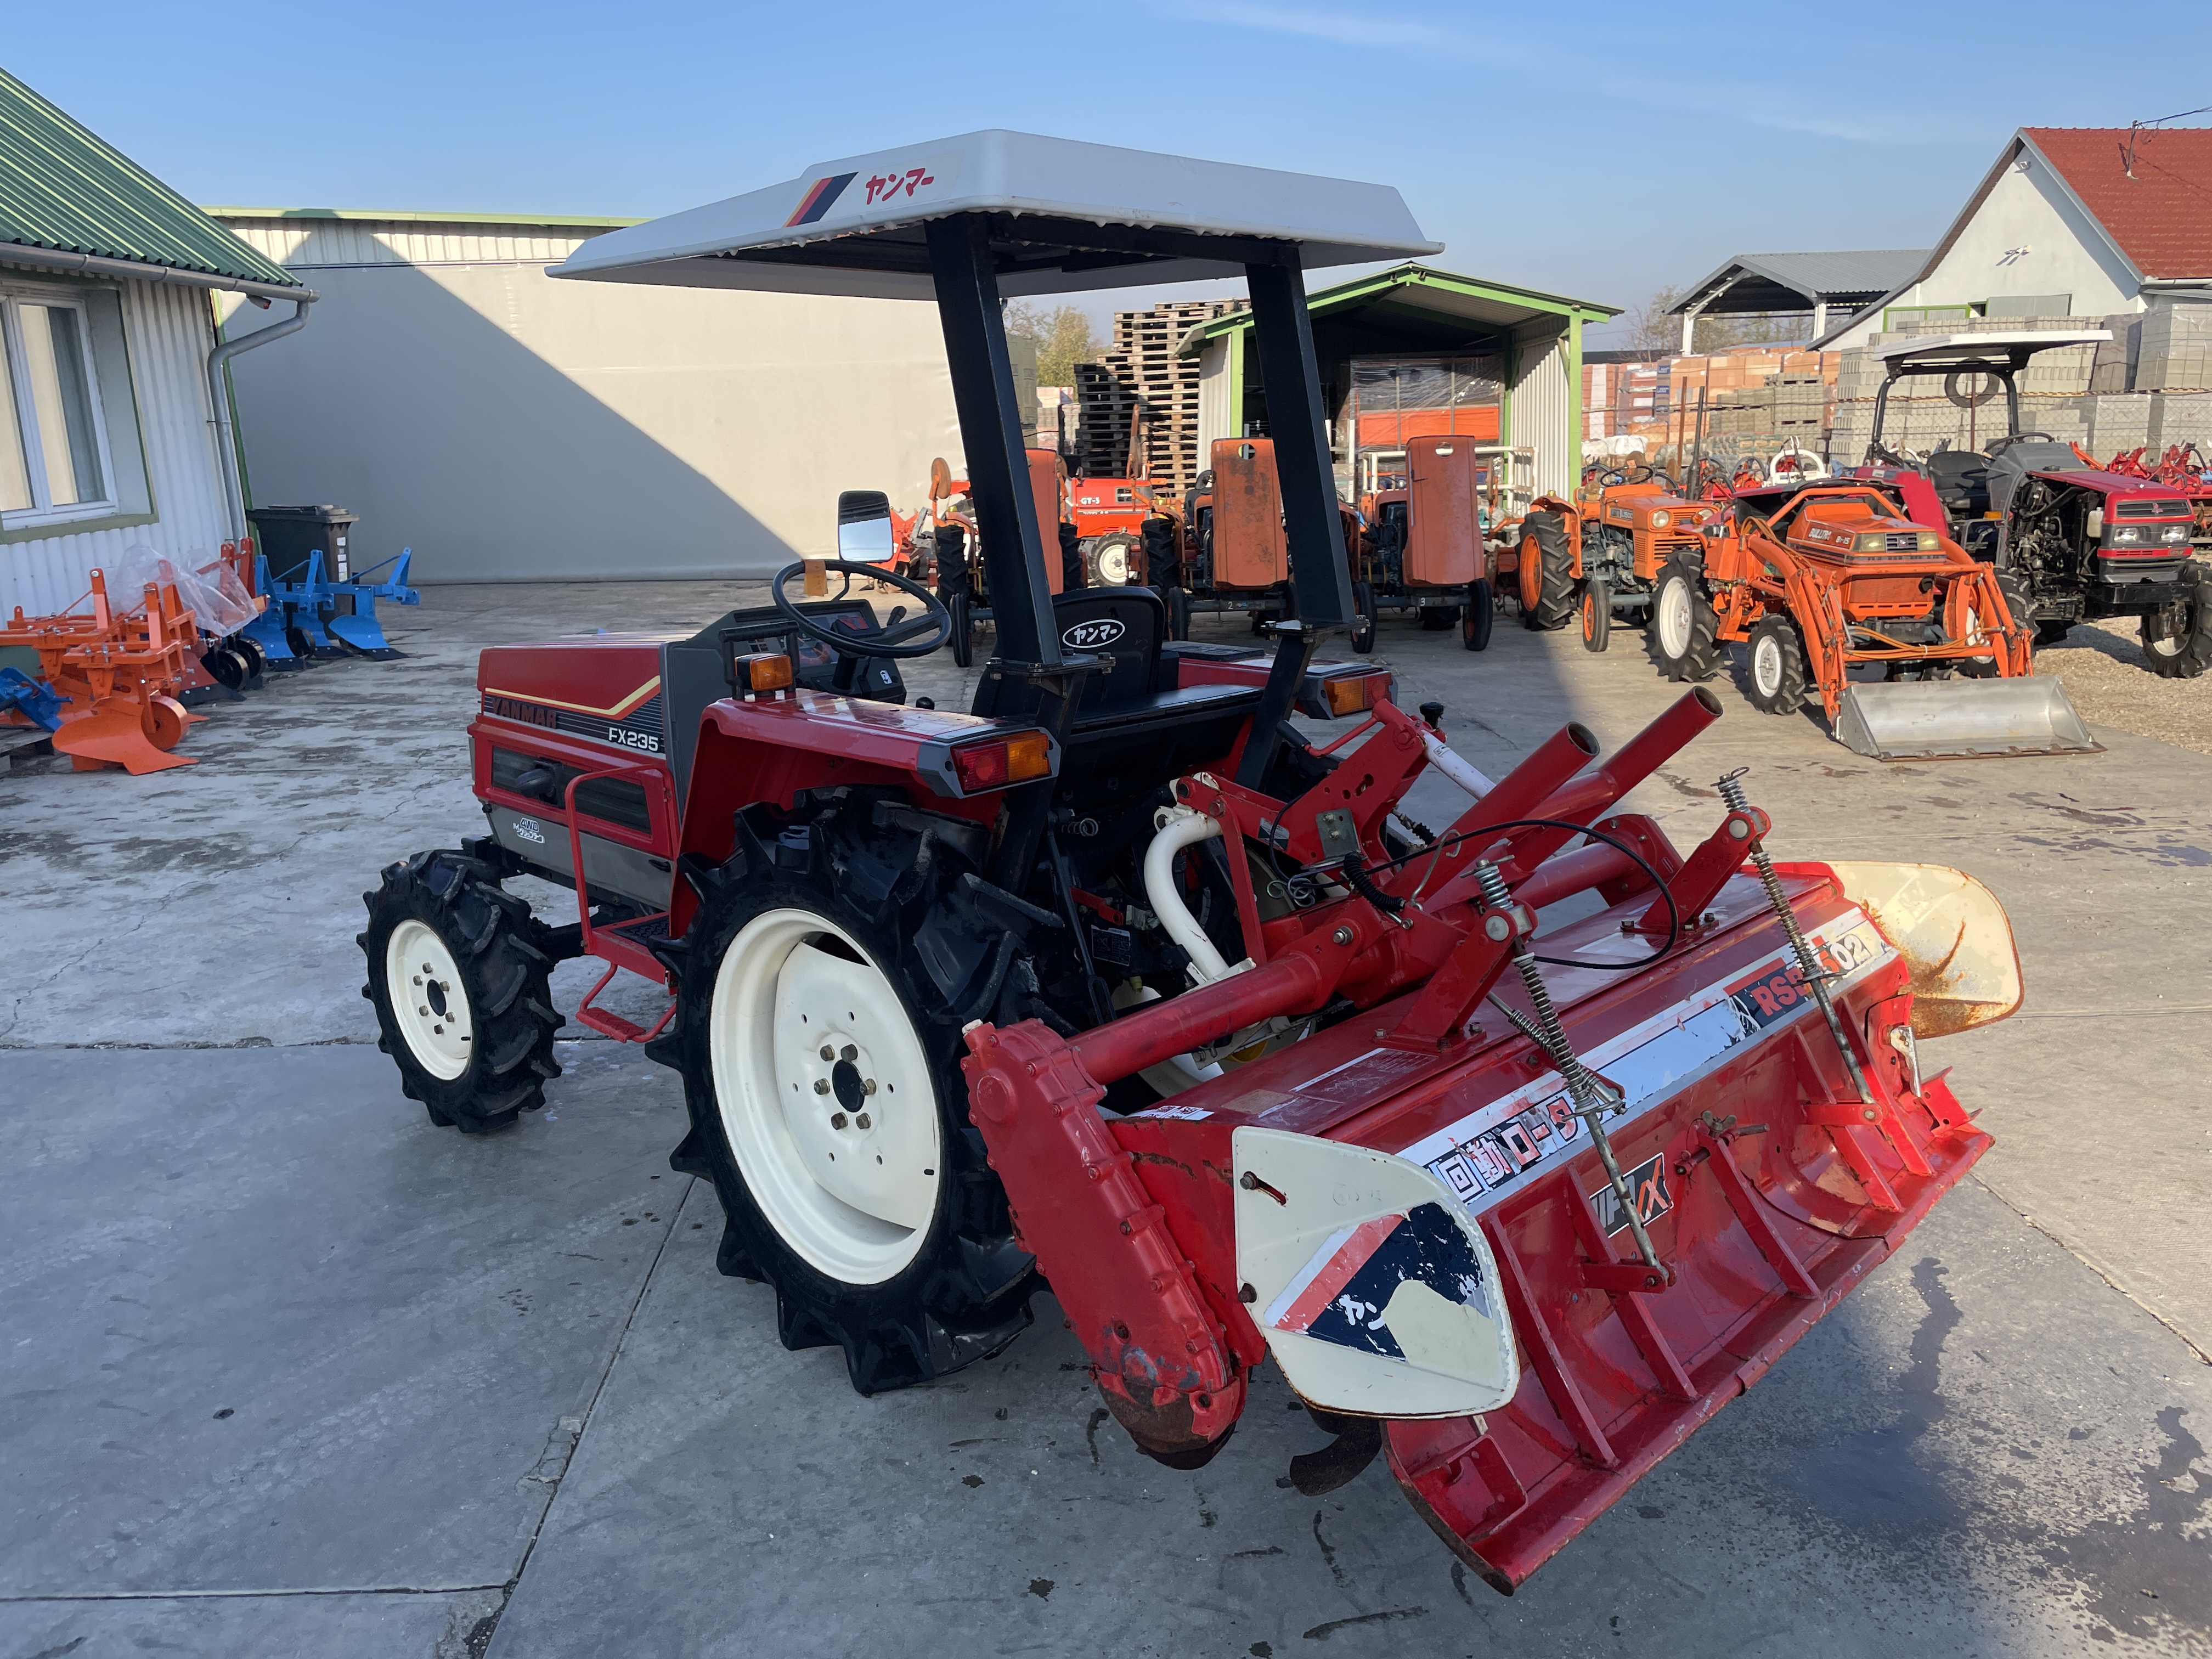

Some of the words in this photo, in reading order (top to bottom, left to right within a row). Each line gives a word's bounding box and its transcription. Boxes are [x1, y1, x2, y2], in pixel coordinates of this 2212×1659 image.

[866, 167, 934, 205] ヤンマー
[1228, 601, 1234, 610] 2
[1420, 597, 1425, 606] 3
[1074, 624, 1118, 645] ヤンマー
[492, 696, 556, 729] YANMAR
[608, 727, 658, 752] FX235
[521, 818, 539, 832] 4WD
